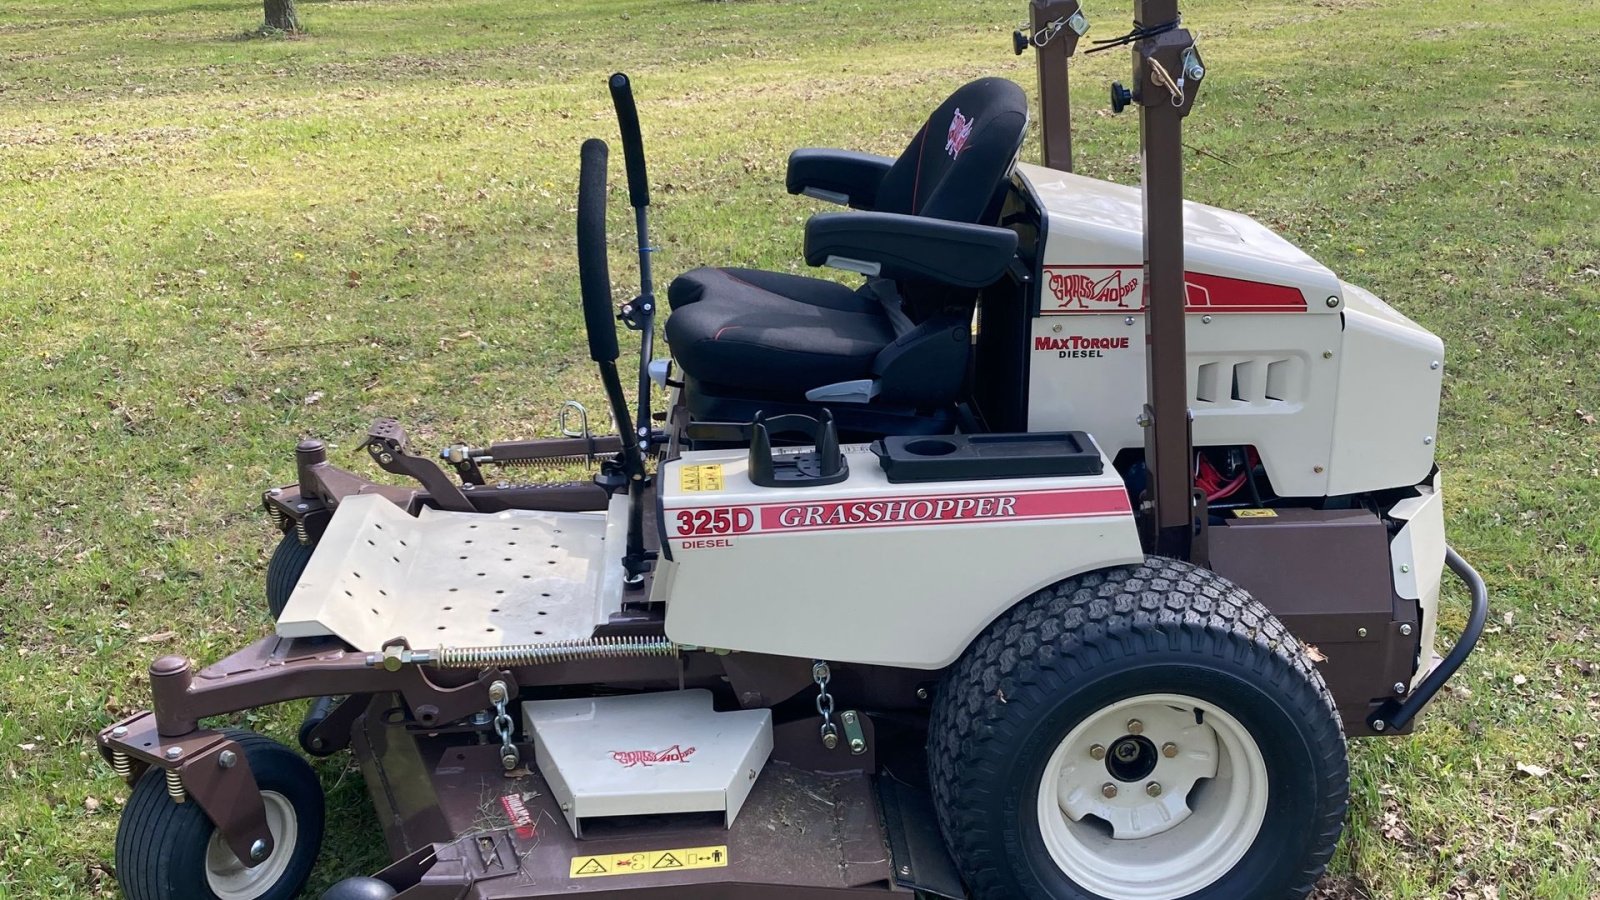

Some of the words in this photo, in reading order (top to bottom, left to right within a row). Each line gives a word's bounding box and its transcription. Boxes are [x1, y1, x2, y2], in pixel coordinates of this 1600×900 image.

[1046, 271, 1137, 307] GRASSHOPPER
[1059, 350, 1103, 358] DIESEL
[677, 508, 754, 535] 325D
[778, 496, 1017, 527] GRASSHOPPER
[682, 540, 733, 549] DIESEL
